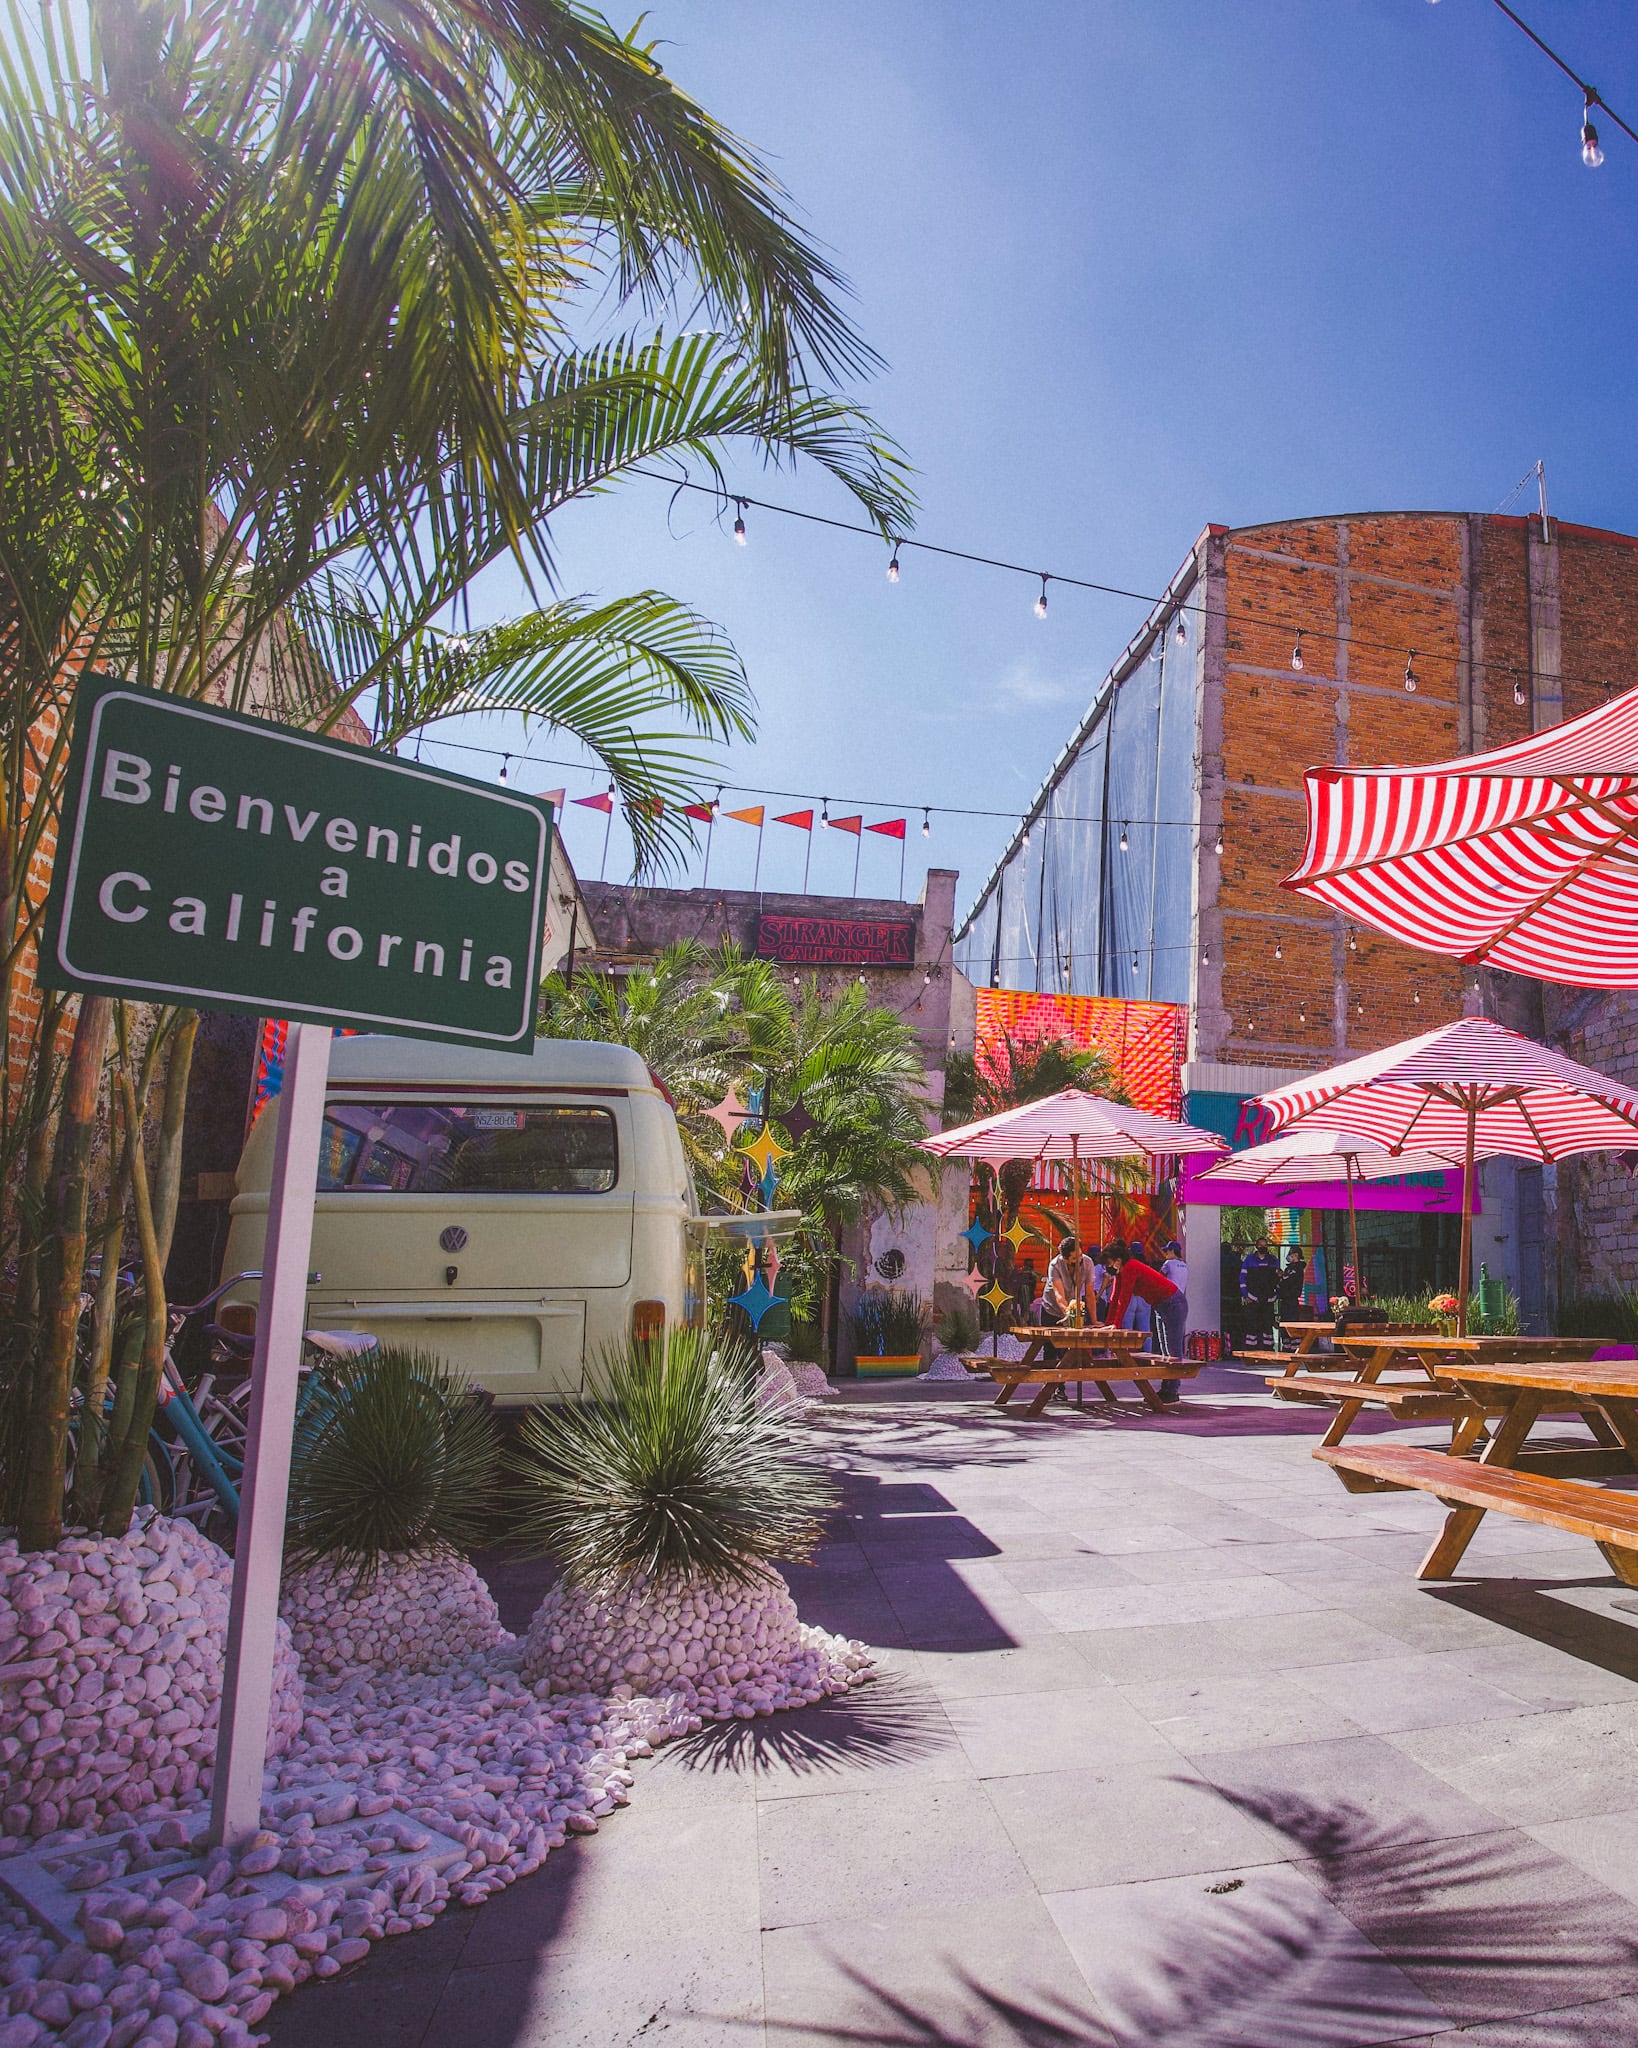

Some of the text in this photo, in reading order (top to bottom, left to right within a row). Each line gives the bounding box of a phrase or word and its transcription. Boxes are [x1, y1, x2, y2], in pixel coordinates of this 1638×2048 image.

[100, 748, 531, 893] Bienvenidos
[320, 865, 348, 898] a
[98, 871, 512, 989] California
[758, 920, 909, 957] STRANGER
[778, 944, 888, 963] CALIFORNIA
[441, 1226, 468, 1252] VW
